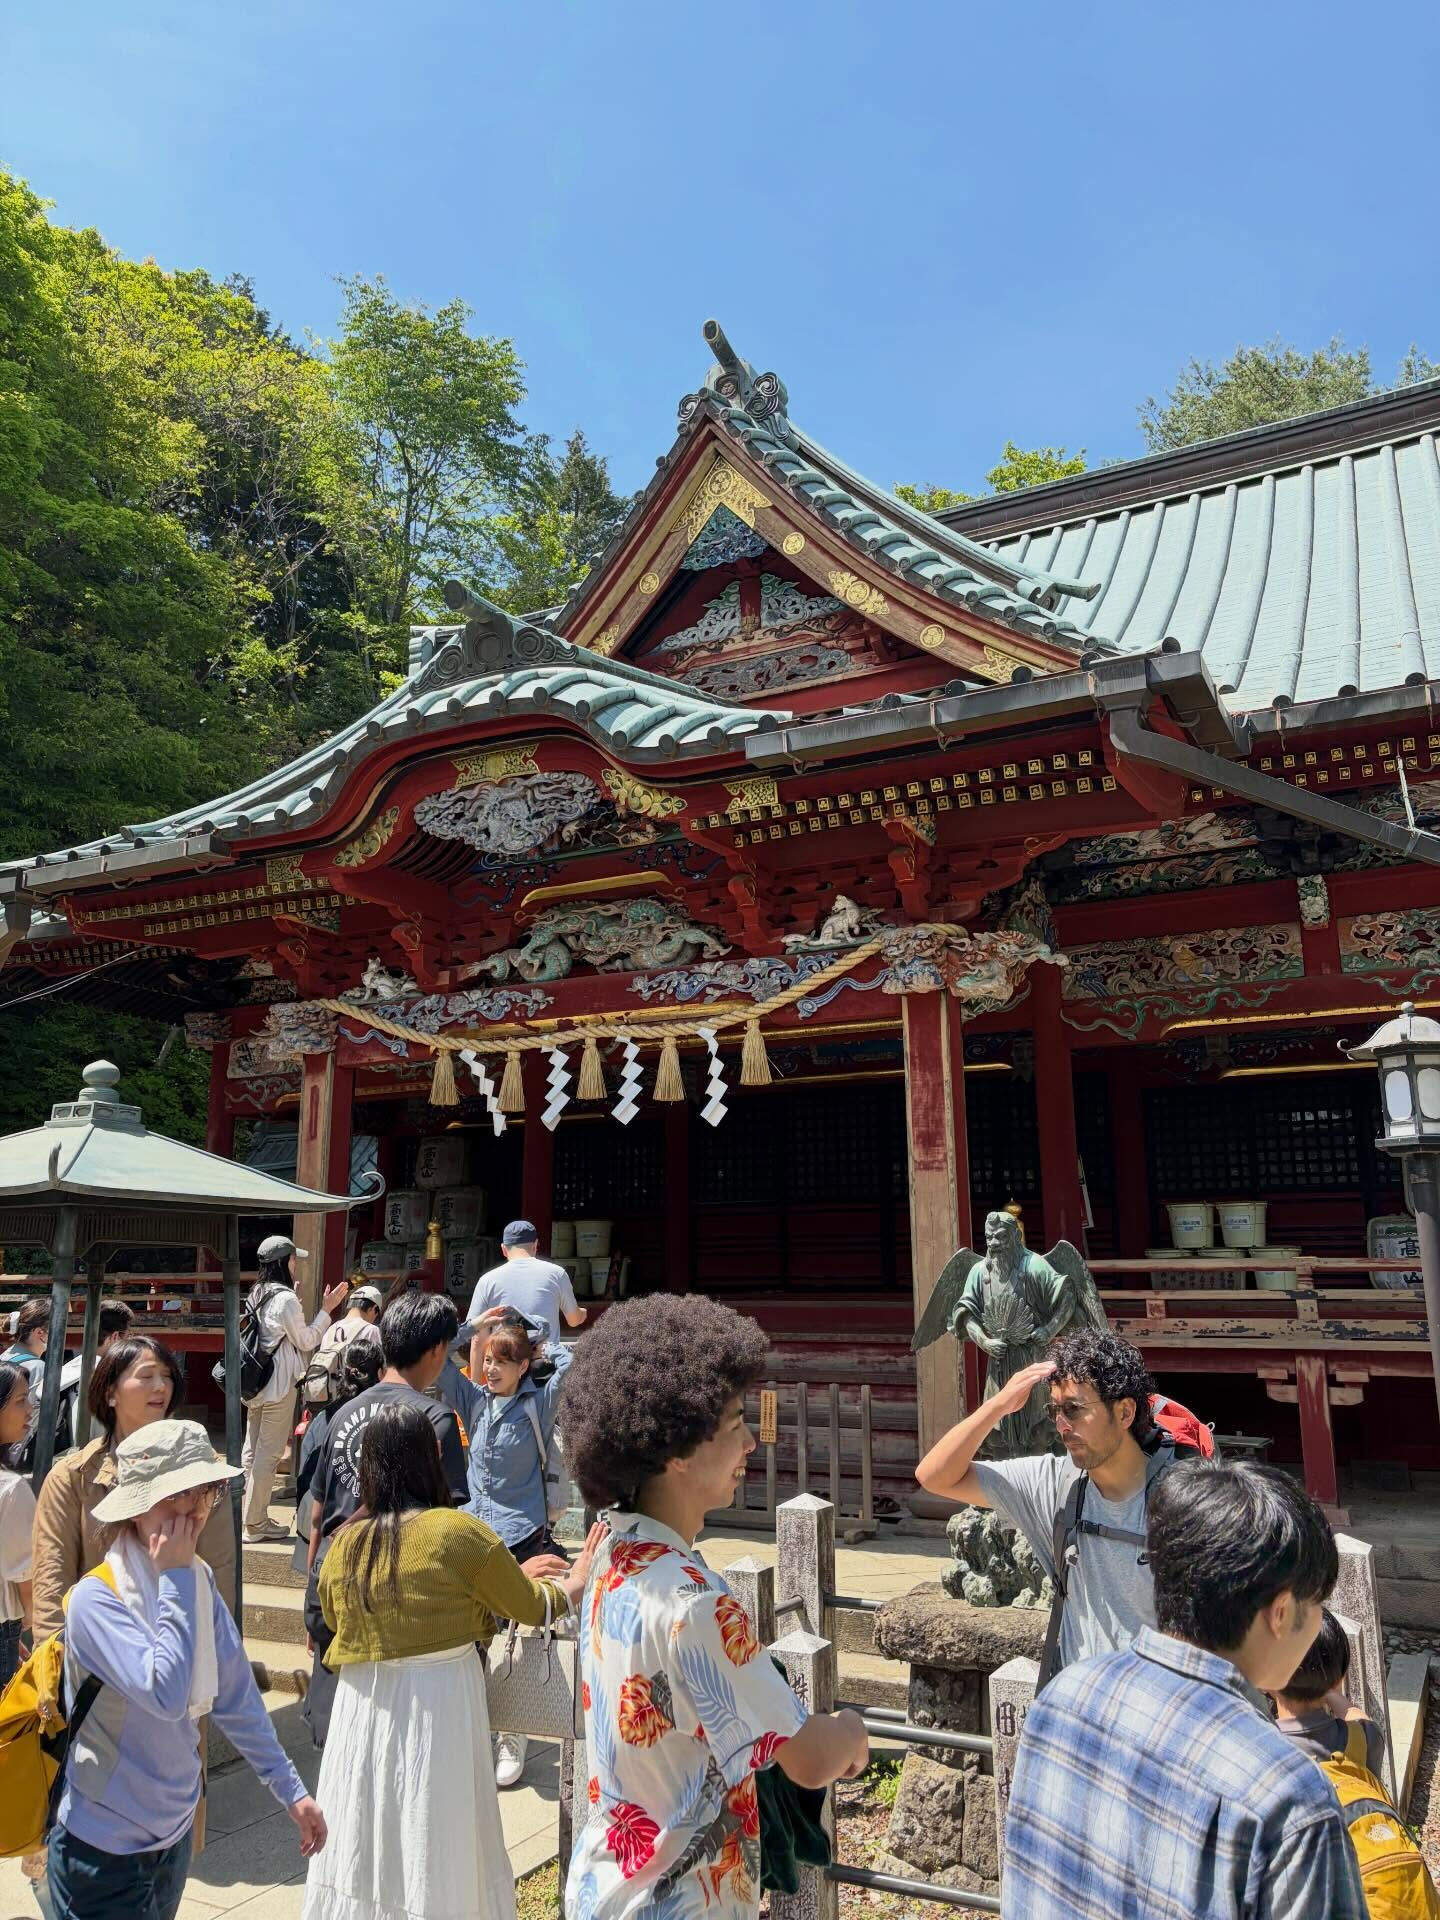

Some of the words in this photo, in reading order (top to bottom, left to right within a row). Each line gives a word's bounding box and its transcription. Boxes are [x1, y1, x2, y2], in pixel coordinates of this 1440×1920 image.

[420, 1146, 438, 1178] 高尾山
[388, 1202, 404, 1237] 高尾山
[408, 1254, 420, 1287] 高山
[451, 1253, 465, 1287] 高尾山
[1399, 1237, 1424, 1284] 高山
[334, 1406, 366, 1449] BRAND
